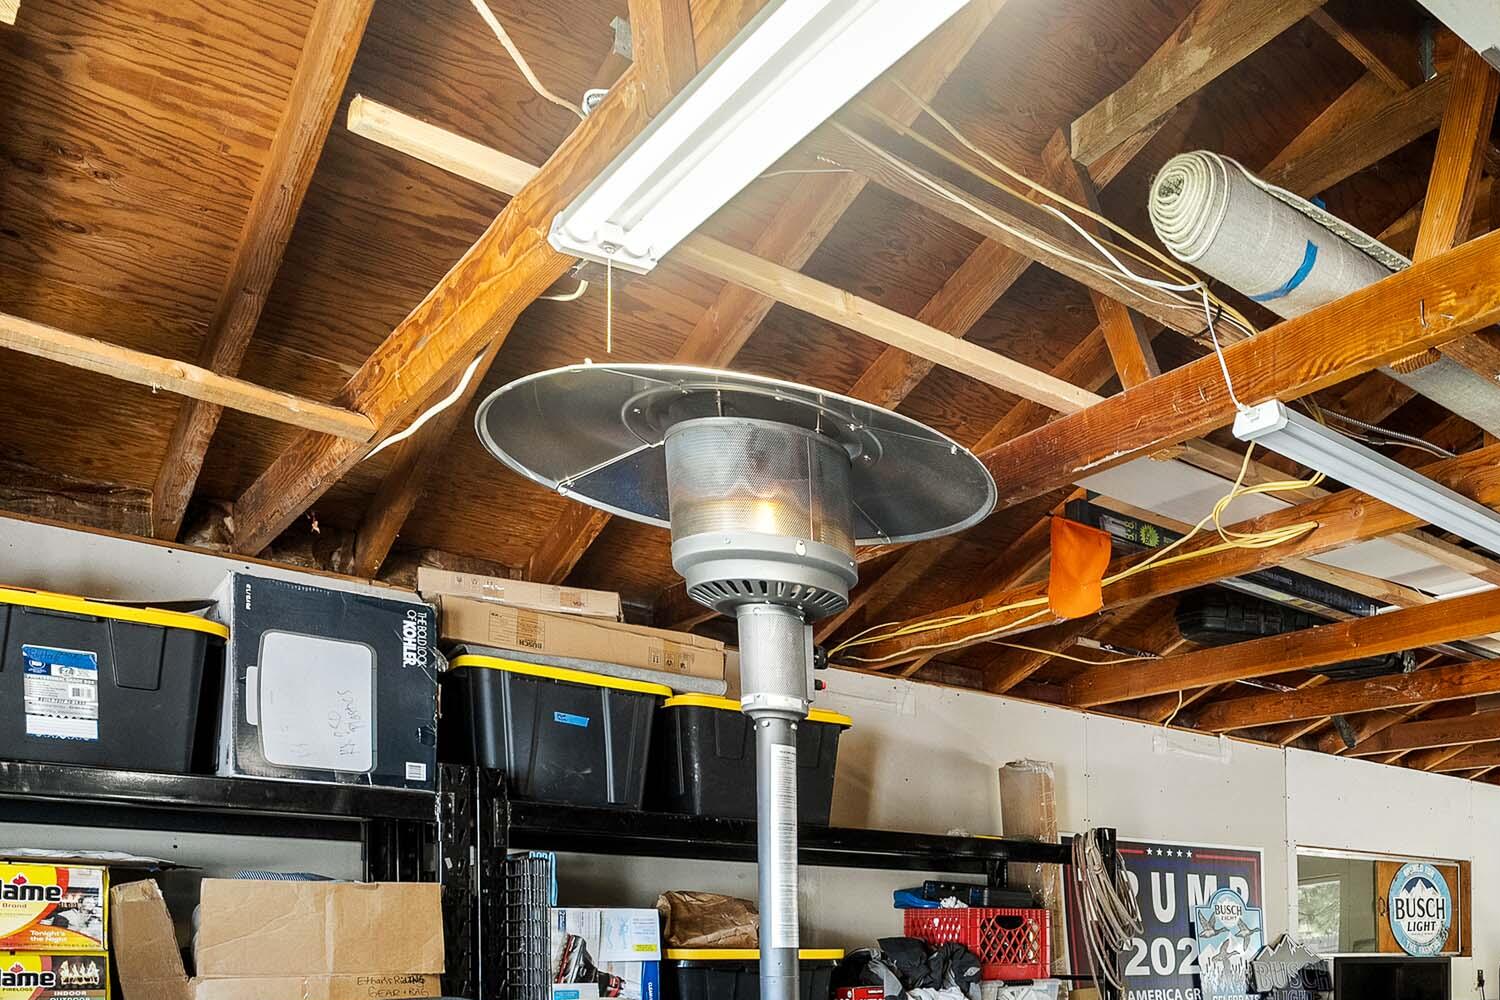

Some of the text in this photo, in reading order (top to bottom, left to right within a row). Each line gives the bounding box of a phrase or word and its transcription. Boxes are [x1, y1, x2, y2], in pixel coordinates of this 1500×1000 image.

[402, 610, 417, 668] OF KOHLER
[417, 612, 427, 668] THE BOLD LOOK
[1119, 870, 1250, 923] RUMP
[1215, 905, 1242, 915] BUSCH
[1394, 897, 1446, 920] BUSCH
[1407, 921, 1437, 932] LIGHT
[1124, 937, 1199, 977] 202
[0, 969, 55, 987] ame
[1253, 960, 1331, 993] BUSCH
